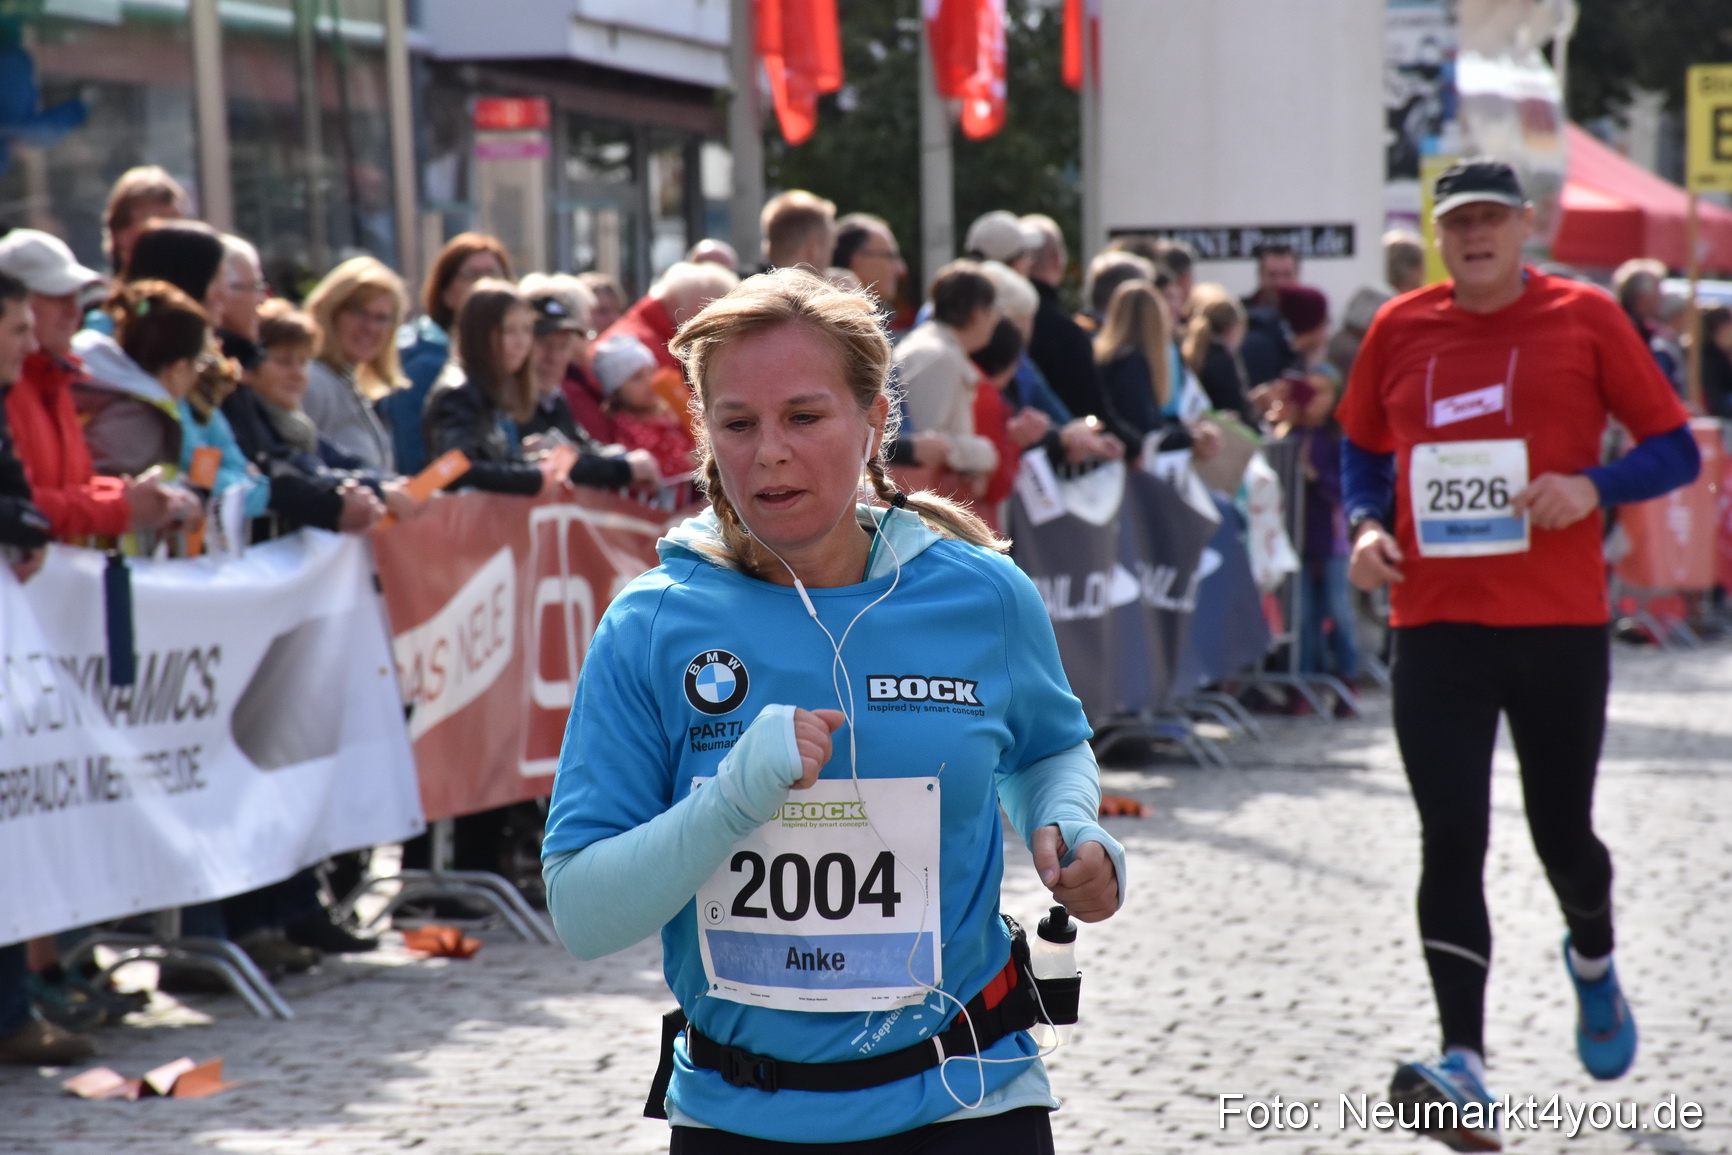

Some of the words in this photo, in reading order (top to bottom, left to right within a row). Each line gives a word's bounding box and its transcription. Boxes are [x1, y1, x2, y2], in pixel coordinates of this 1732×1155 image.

[1427, 477, 1509, 513] 2526
[688, 652, 741, 676] BMW
[867, 676, 981, 705] BOCK
[867, 703, 907, 713] inspired
[909, 704, 921, 713] by
[923, 705, 950, 713] smart
[952, 708, 985, 717] concepts
[783, 802, 867, 821] BOCK
[782, 821, 808, 829] inspired
[809, 821, 818, 829] by
[730, 850, 902, 922] 2004
[711, 906, 719, 920] C
[785, 946, 846, 972] Anke
[859, 1041, 876, 1055] 17.
